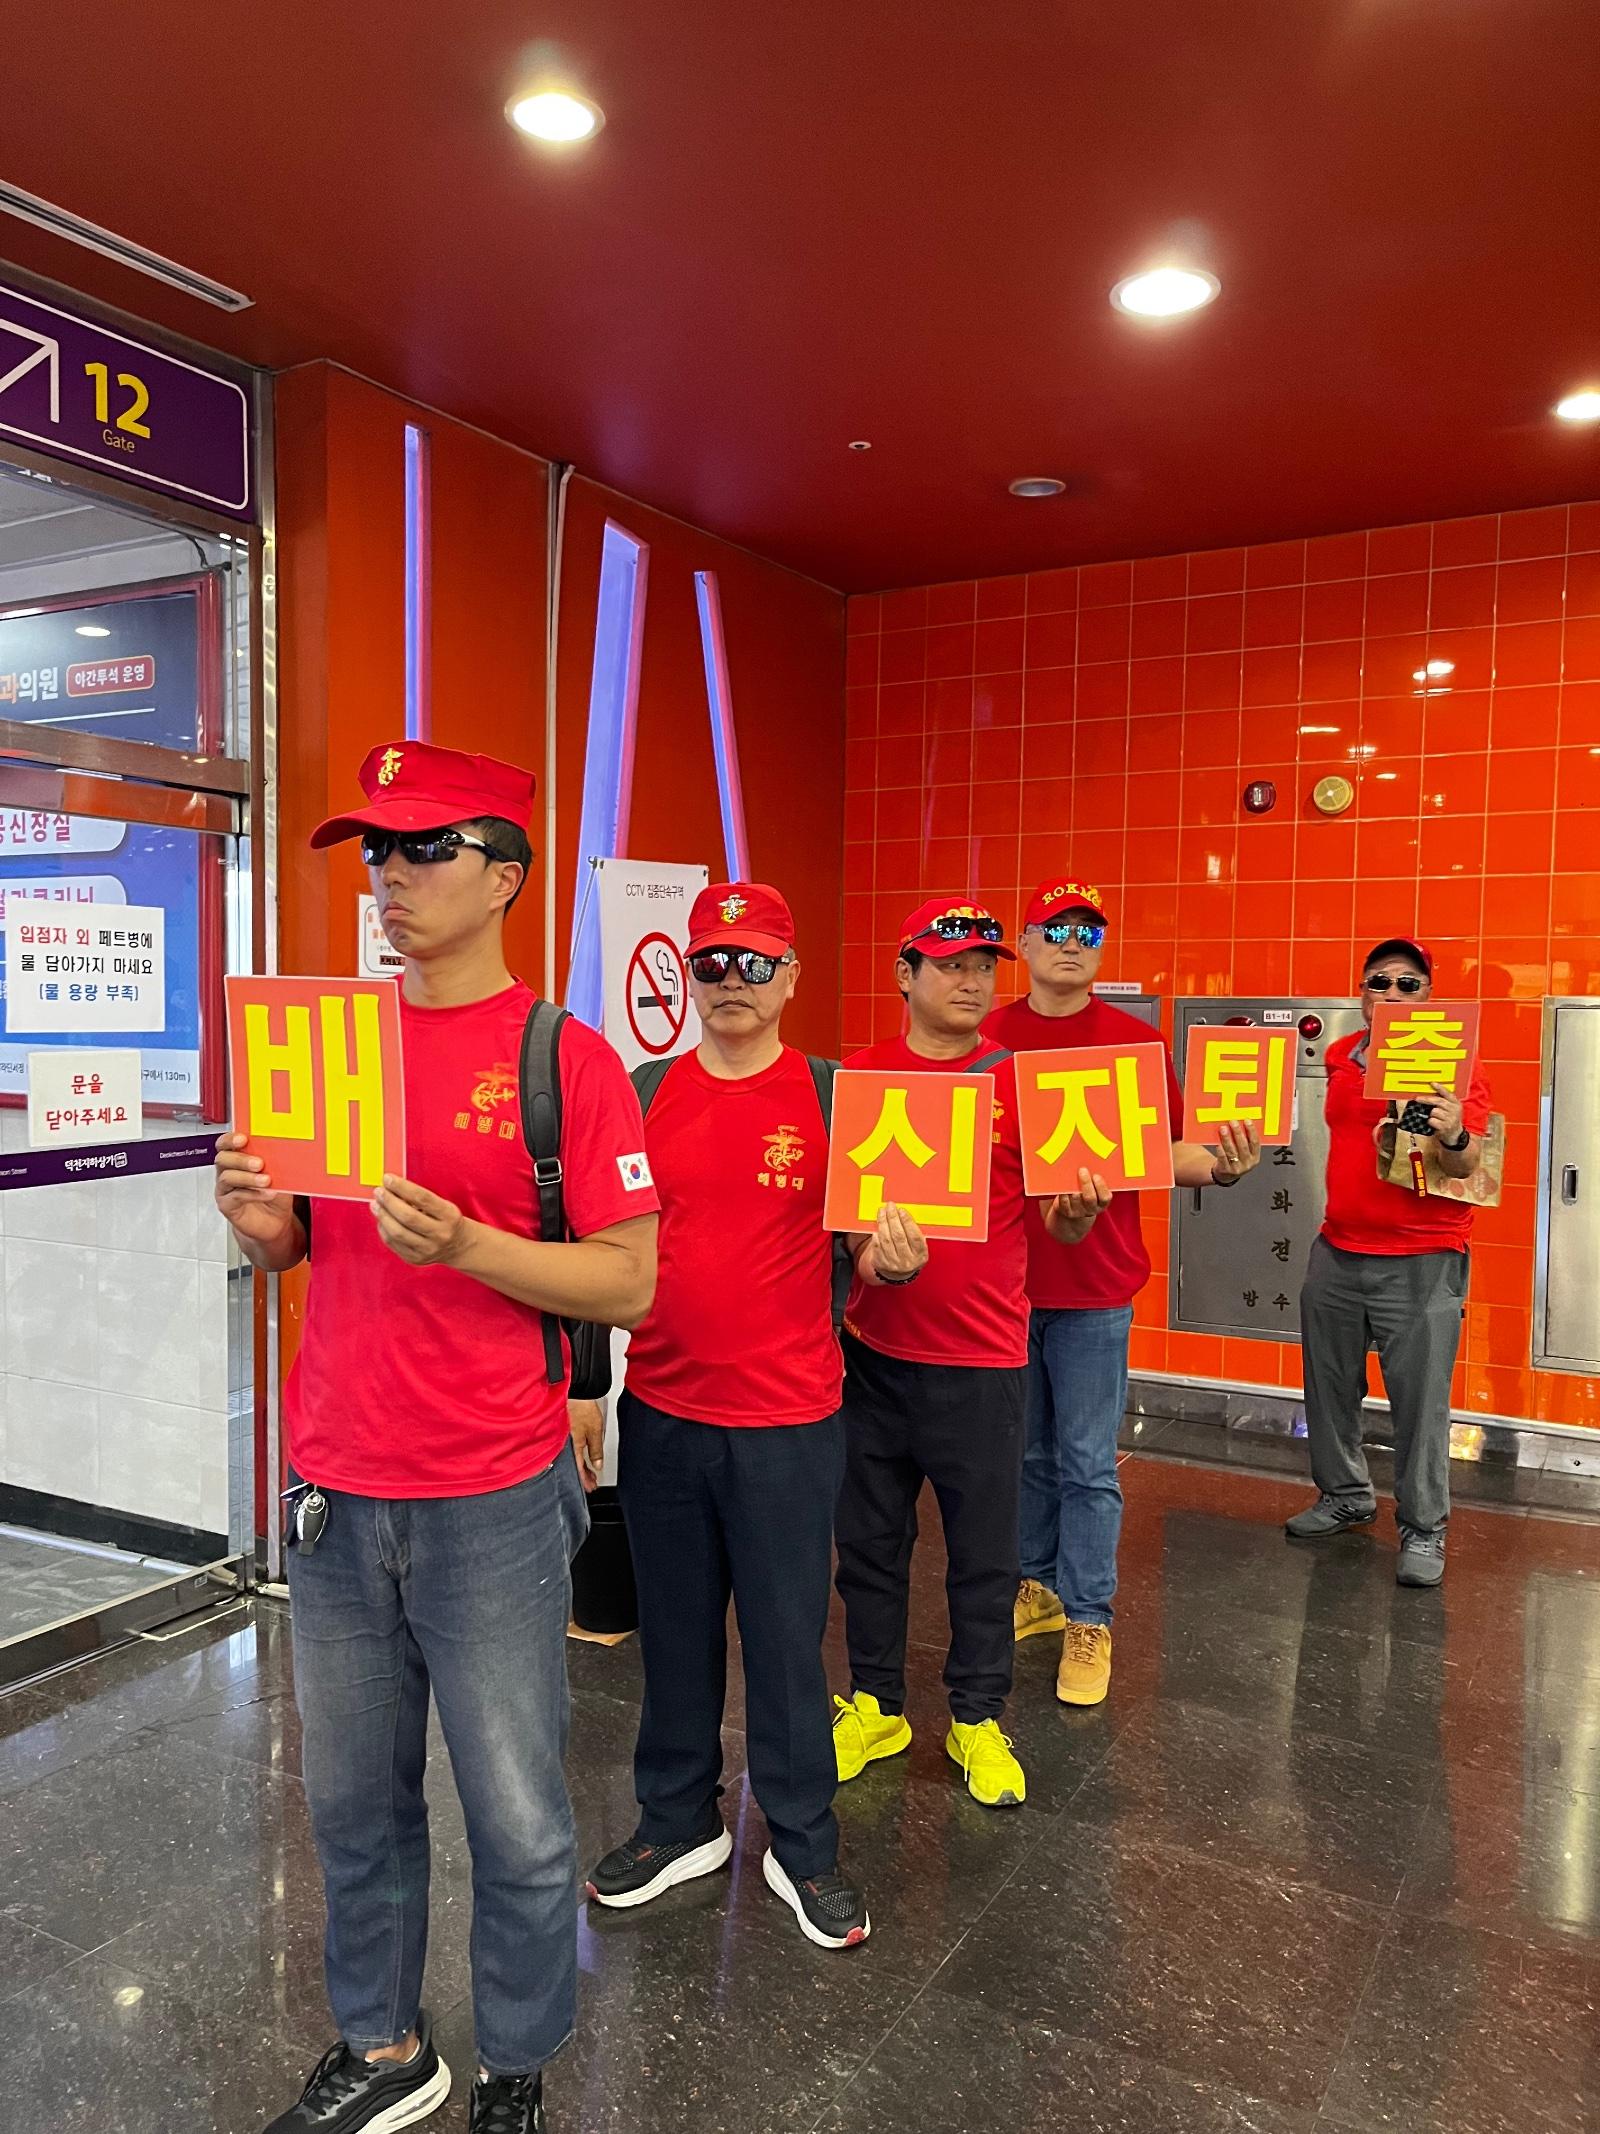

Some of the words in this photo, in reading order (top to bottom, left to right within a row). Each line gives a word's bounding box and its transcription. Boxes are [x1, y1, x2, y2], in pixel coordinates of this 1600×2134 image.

[84, 362, 150, 439] 12
[102, 429, 136, 453] Gate
[75, 667, 119, 688] 야간투석
[123, 663, 145, 682] 운영
[626, 883, 645, 897] CCTV
[647, 884, 684, 900] 집중단속구역
[20, 925, 67, 945] 입점자
[76, 928, 90, 946] 외
[98, 930, 153, 949] 페트병에
[20, 954, 35, 972] 물
[46, 956, 105, 974] 담아가지
[113, 958, 153, 975] 마세요
[68, 983, 98, 1002] 용량
[106, 985, 139, 1002] 부족)
[1265, 1012, 1291, 1020] B1-14
[1377, 1011, 1468, 1093] 출
[71, 1073, 104, 1095] 문을
[244, 993, 385, 1187] 배
[1195, 1036, 1287, 1136] 퇴
[46, 1106, 129, 1131] 닫아주세요
[1035, 1056, 1158, 1178] 자
[845, 1086, 978, 1228] 신
